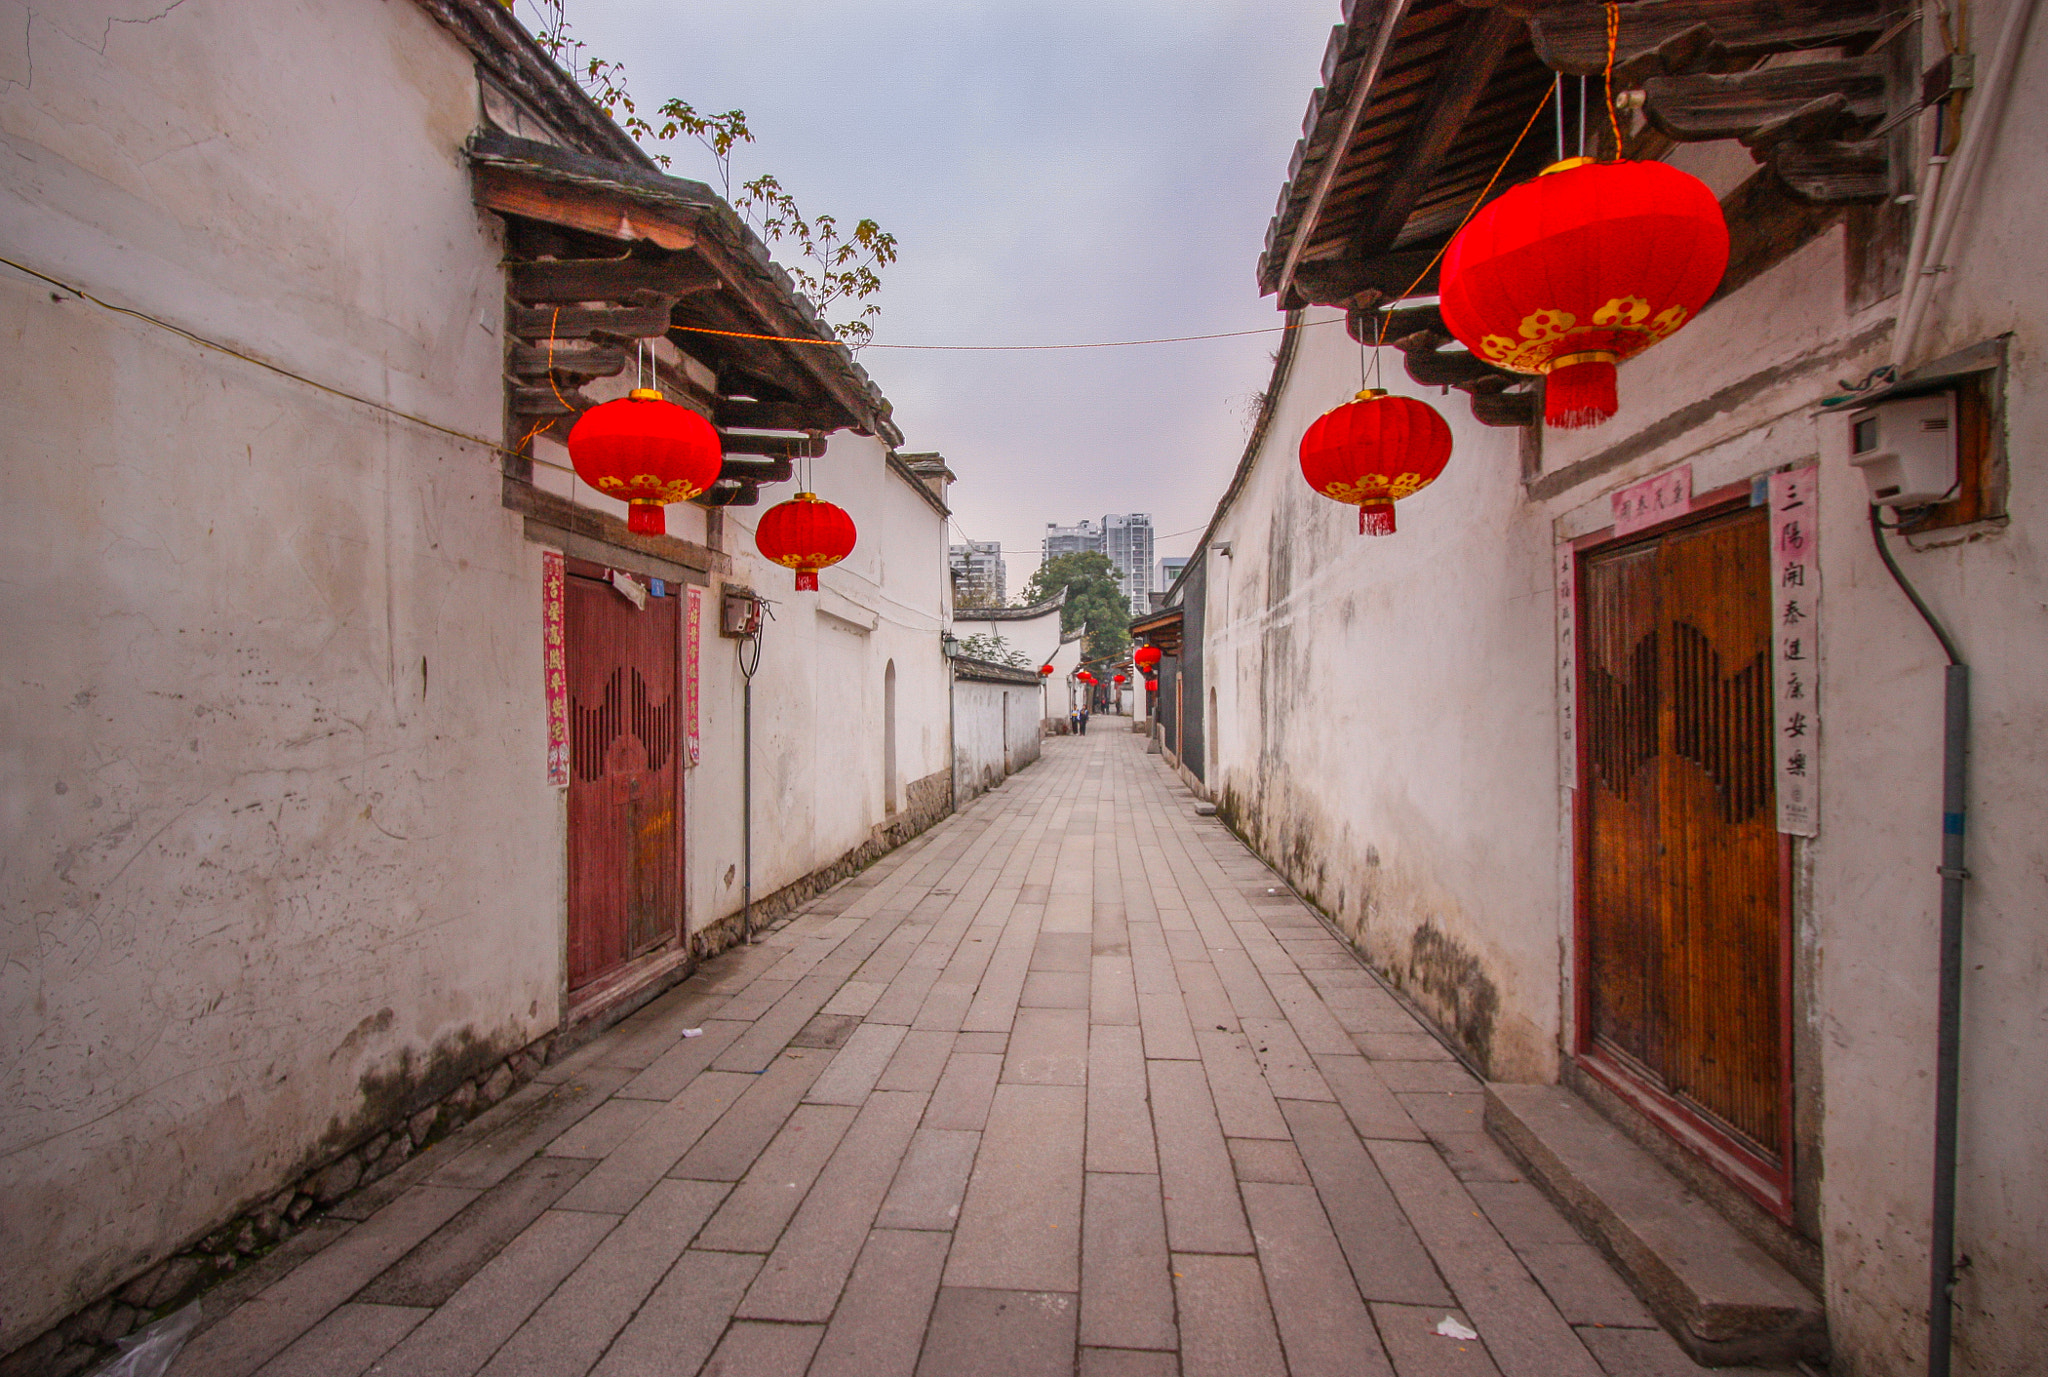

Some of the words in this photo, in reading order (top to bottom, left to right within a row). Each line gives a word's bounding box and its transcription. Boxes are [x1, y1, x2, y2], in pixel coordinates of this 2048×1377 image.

[548, 576, 566, 742] 吉星高照平安宅
